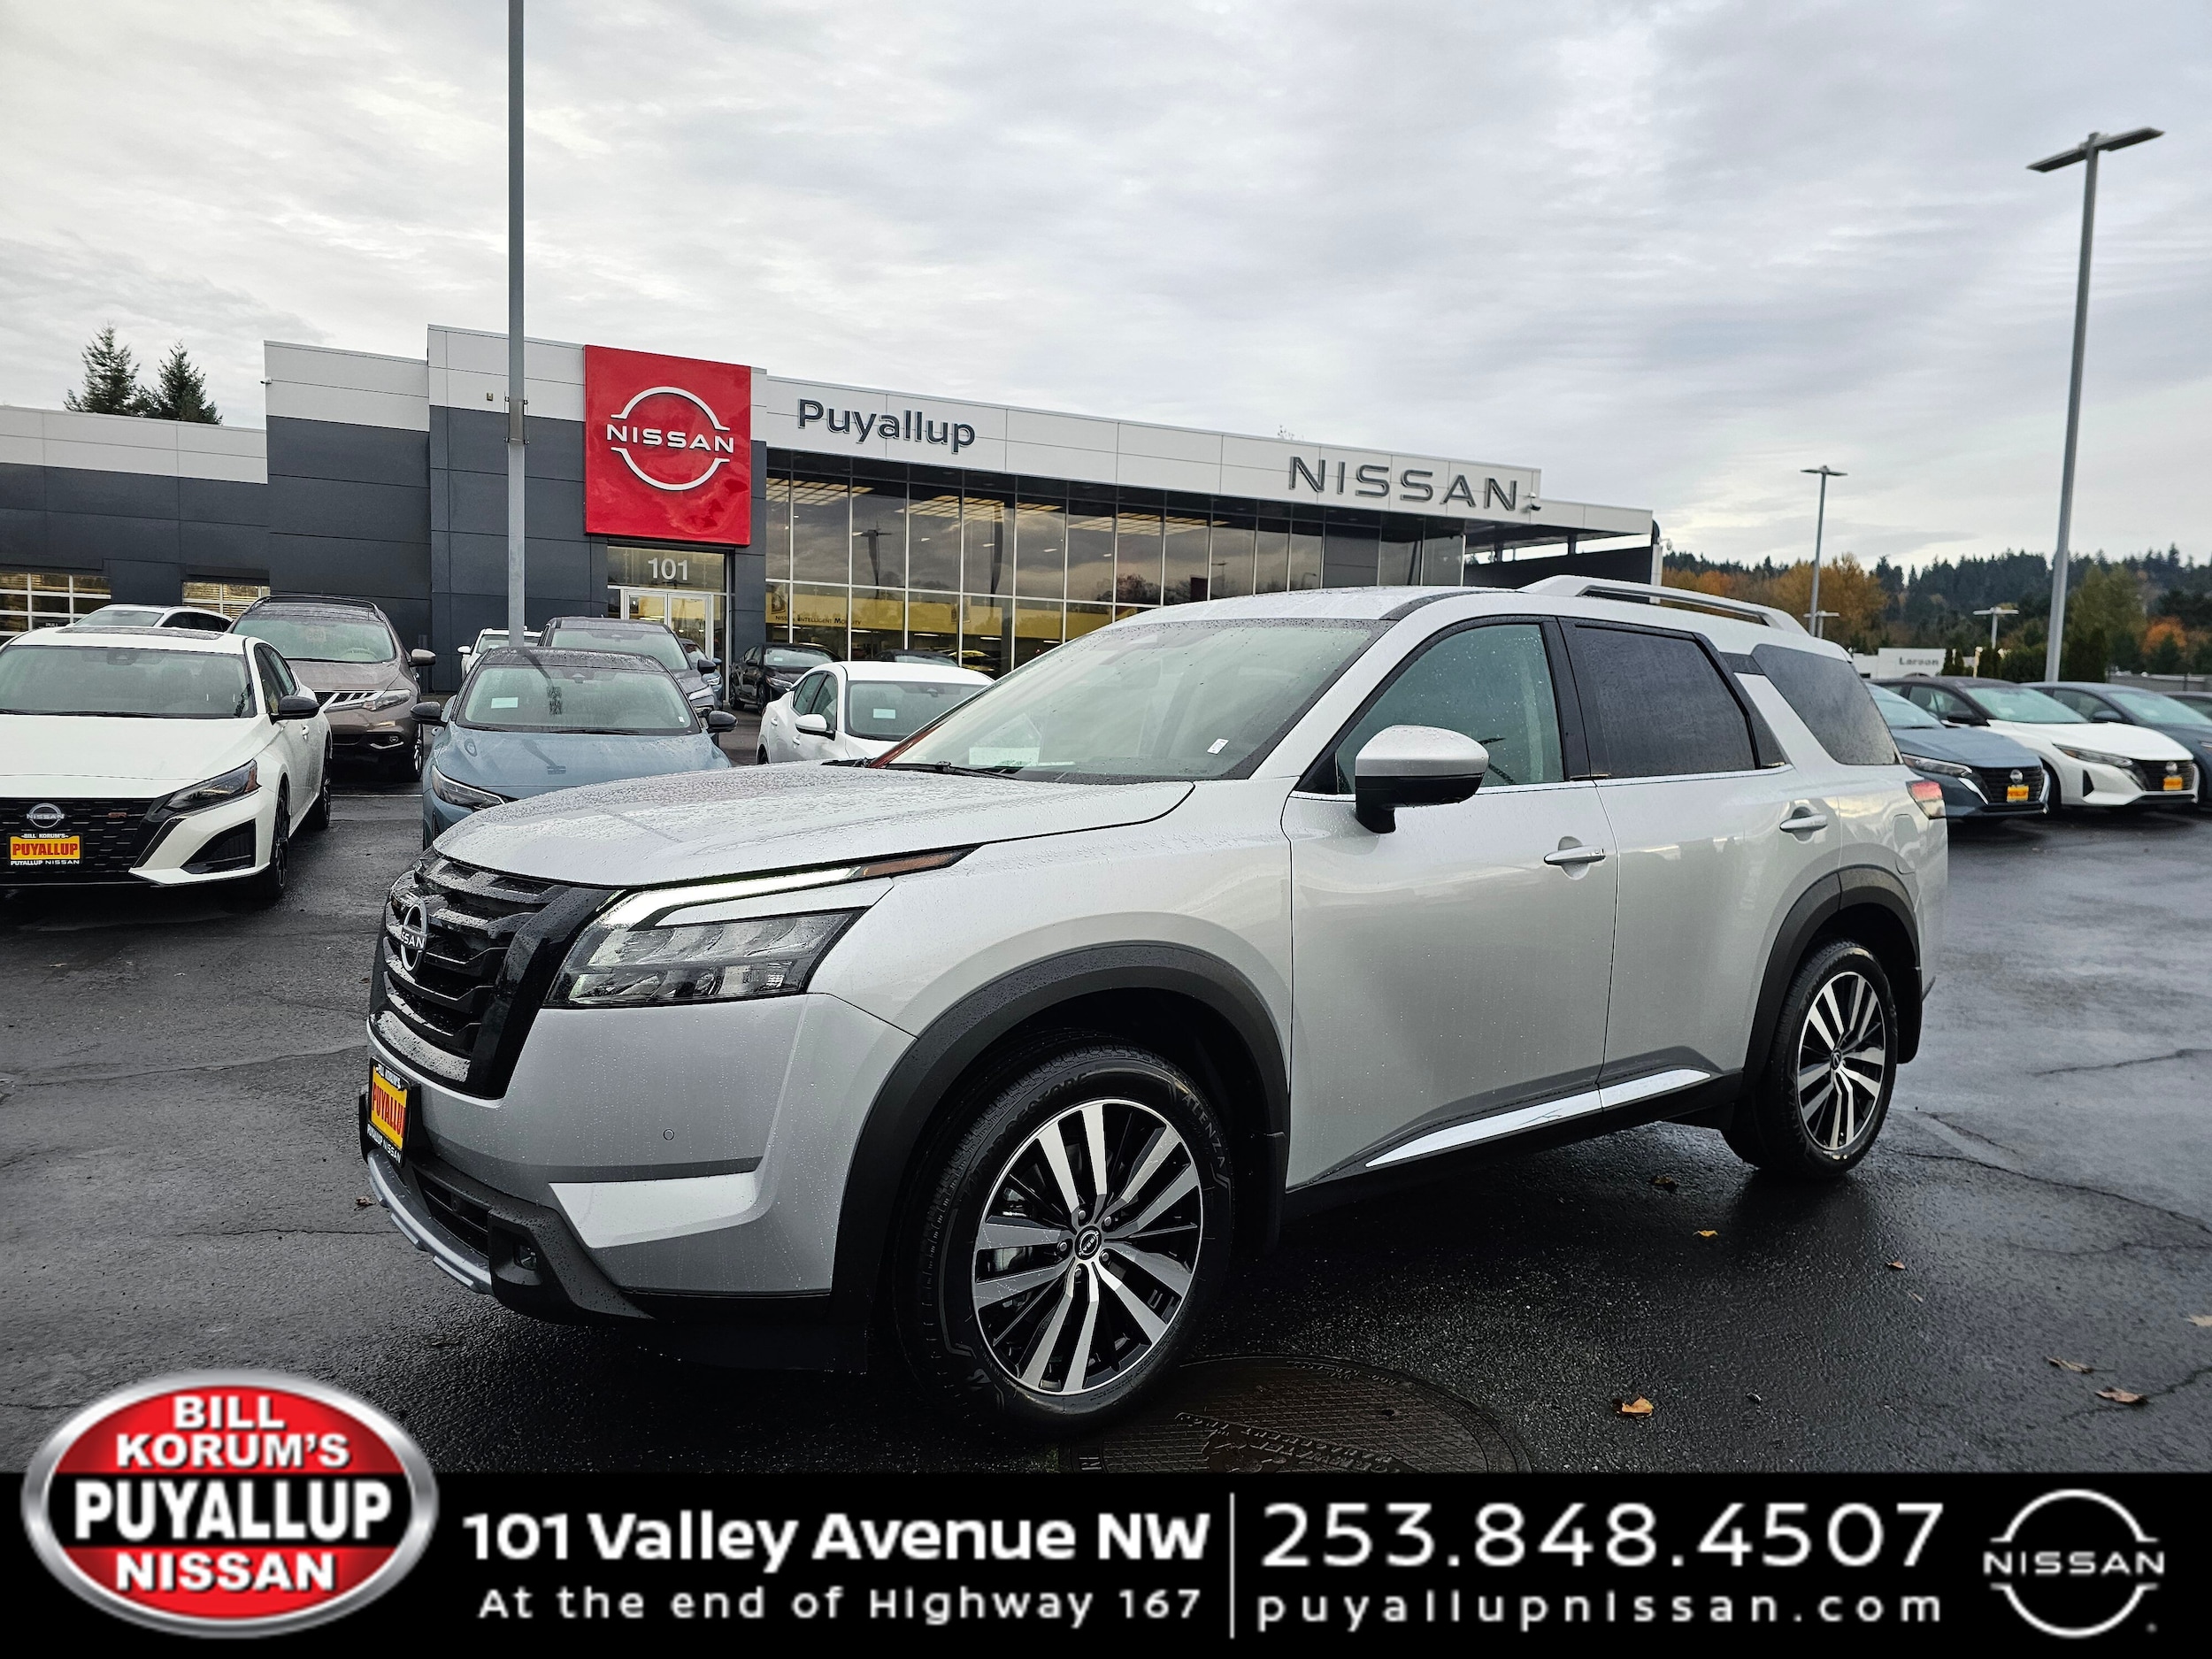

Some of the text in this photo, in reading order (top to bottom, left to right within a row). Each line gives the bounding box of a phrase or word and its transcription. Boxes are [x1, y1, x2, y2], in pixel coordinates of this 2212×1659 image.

[606, 423, 735, 454] NISSAN
[798, 398, 976, 454] Puyallup
[1288, 456, 1517, 511] NISSAN
[647, 557, 688, 581] 101
[12, 842, 78, 856] PUYALLUP
